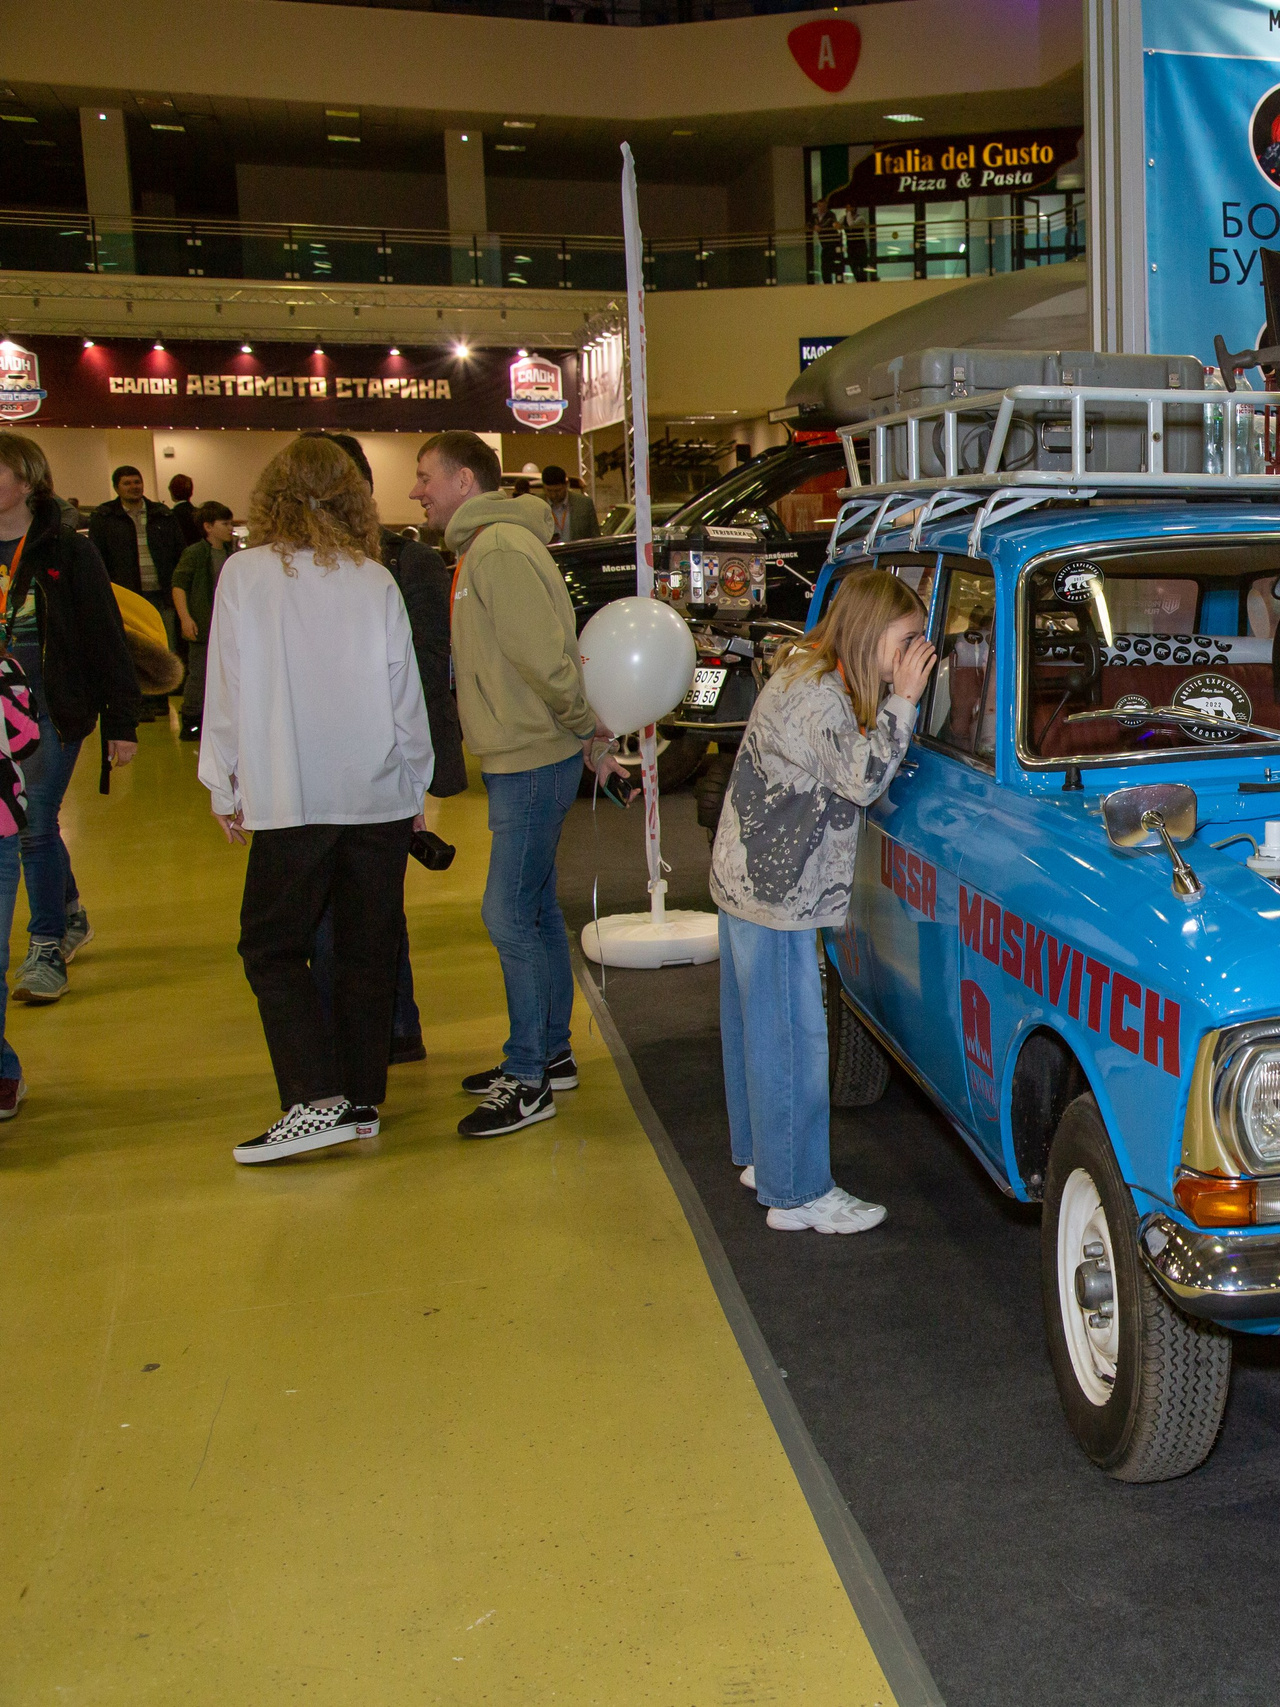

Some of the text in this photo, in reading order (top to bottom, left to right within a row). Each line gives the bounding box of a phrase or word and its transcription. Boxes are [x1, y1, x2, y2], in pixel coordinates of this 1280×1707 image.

[874, 141, 1054, 175] Italia del Gusto
[898, 169, 1033, 193] Pizza & Pasta
[0, 355, 31, 371] АЛОН
[517, 367, 555, 383] САЛОН
[109, 375, 452, 399] САЛОН АВТОМОТО СТАРИНА
[765, 552, 798, 560] елябинск
[602, 563, 636, 573] Москва
[695, 671, 721, 683] 8075
[702, 690, 716, 703] 50
[1179, 678, 1245, 703] ARCTIC EXPLORERS
[1192, 726, 1234, 738] RGOEXP
[881, 835, 1181, 1079] USSR MOSKVITCH
